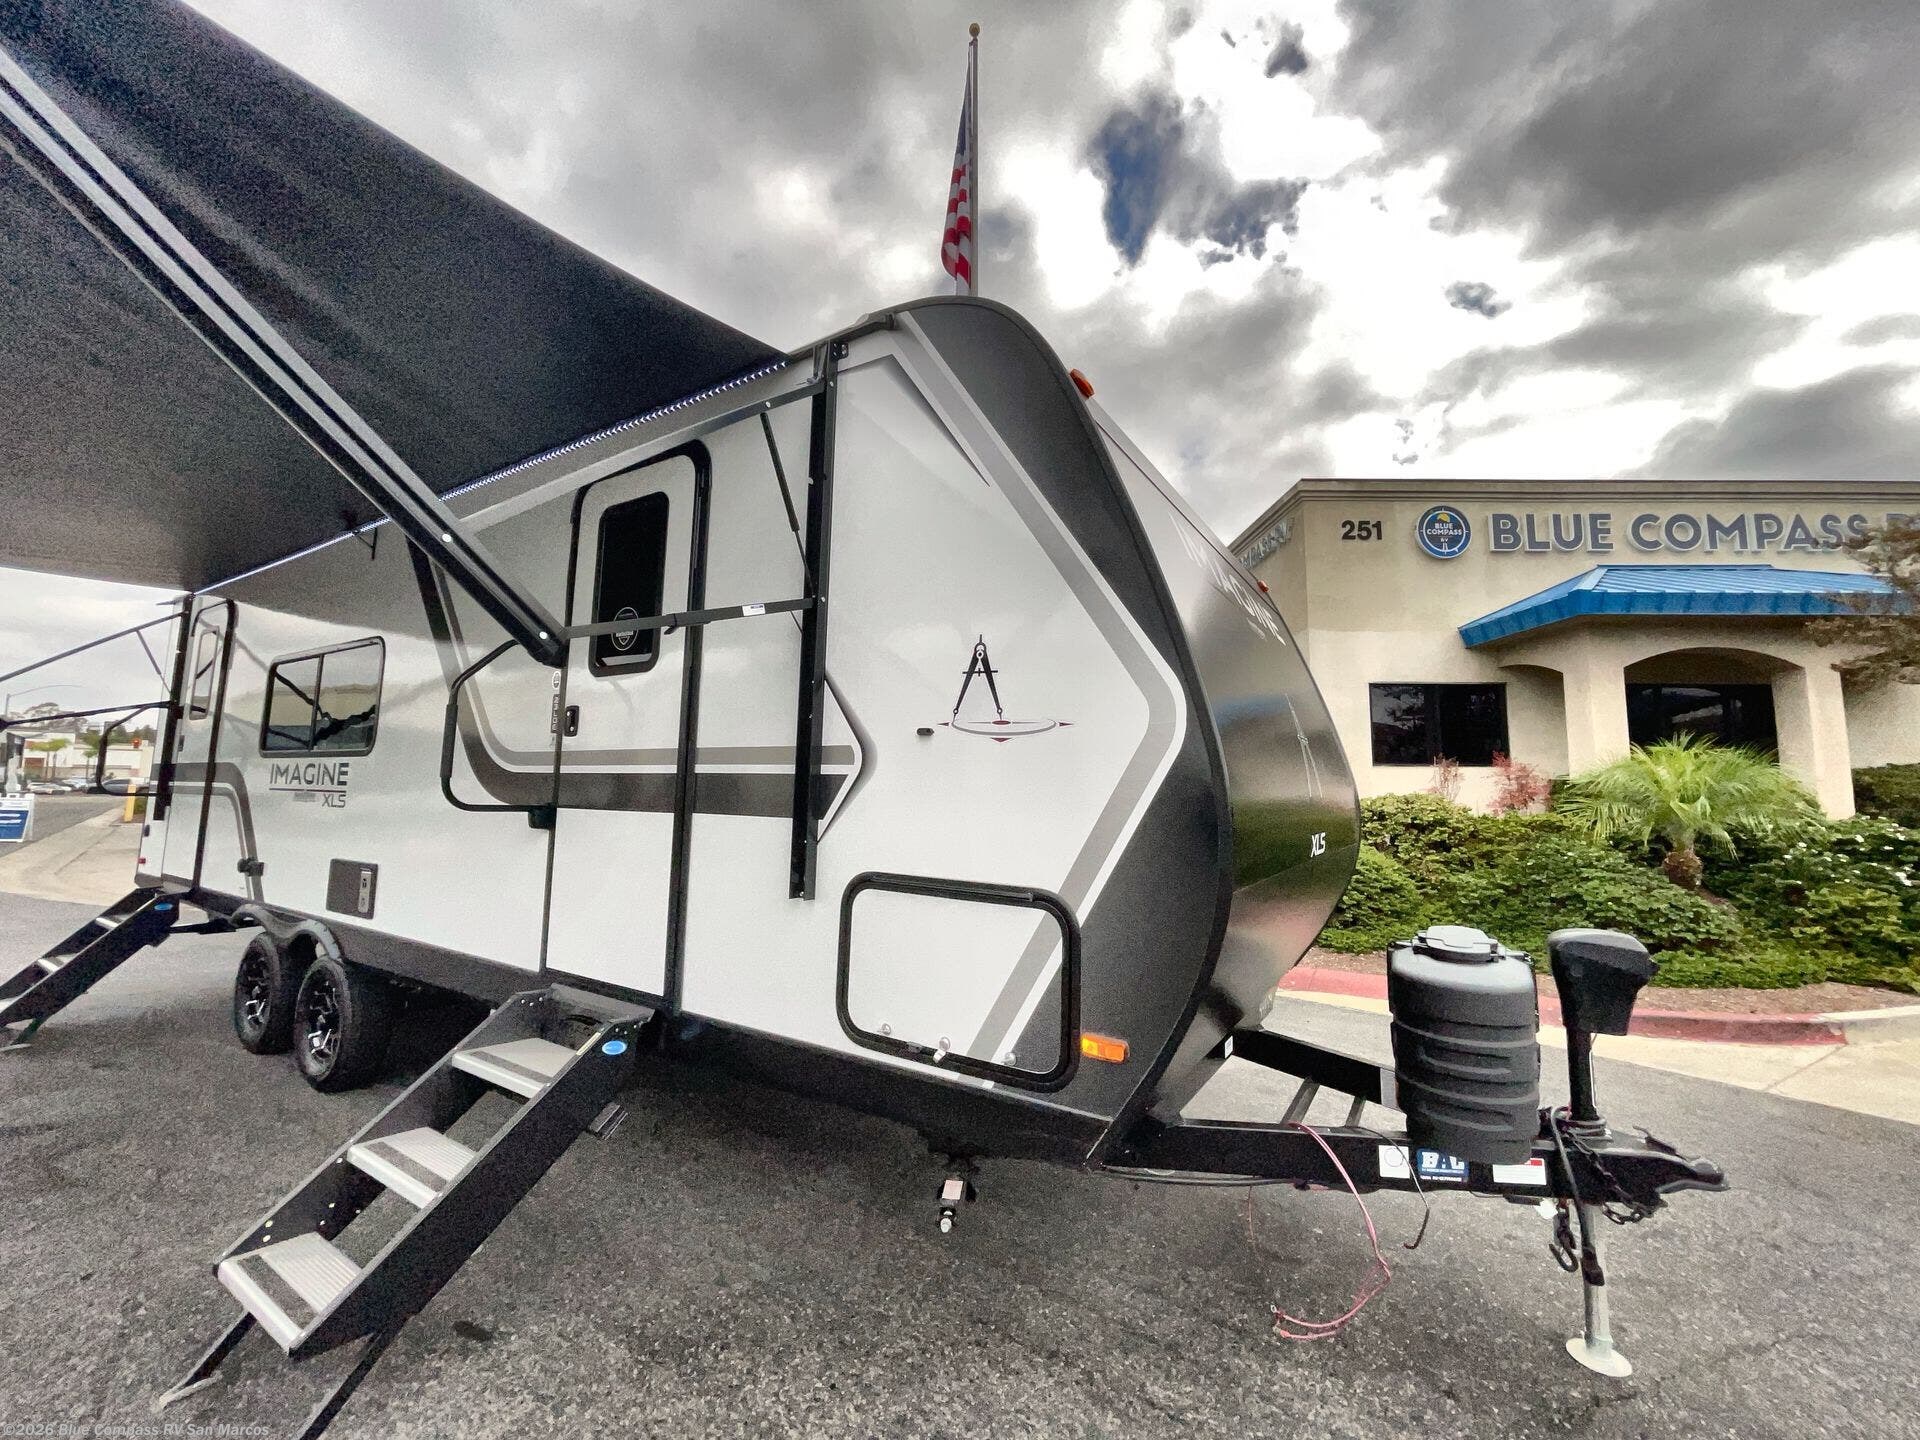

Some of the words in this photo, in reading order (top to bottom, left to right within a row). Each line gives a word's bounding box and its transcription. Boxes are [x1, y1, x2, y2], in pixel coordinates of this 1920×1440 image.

[1341, 520, 1382, 540] 251
[1490, 512, 1615, 551] BLUE
[270, 762, 350, 786] IMAGINE
[321, 793, 347, 808] XLS
[1310, 832, 1326, 858] XLS
